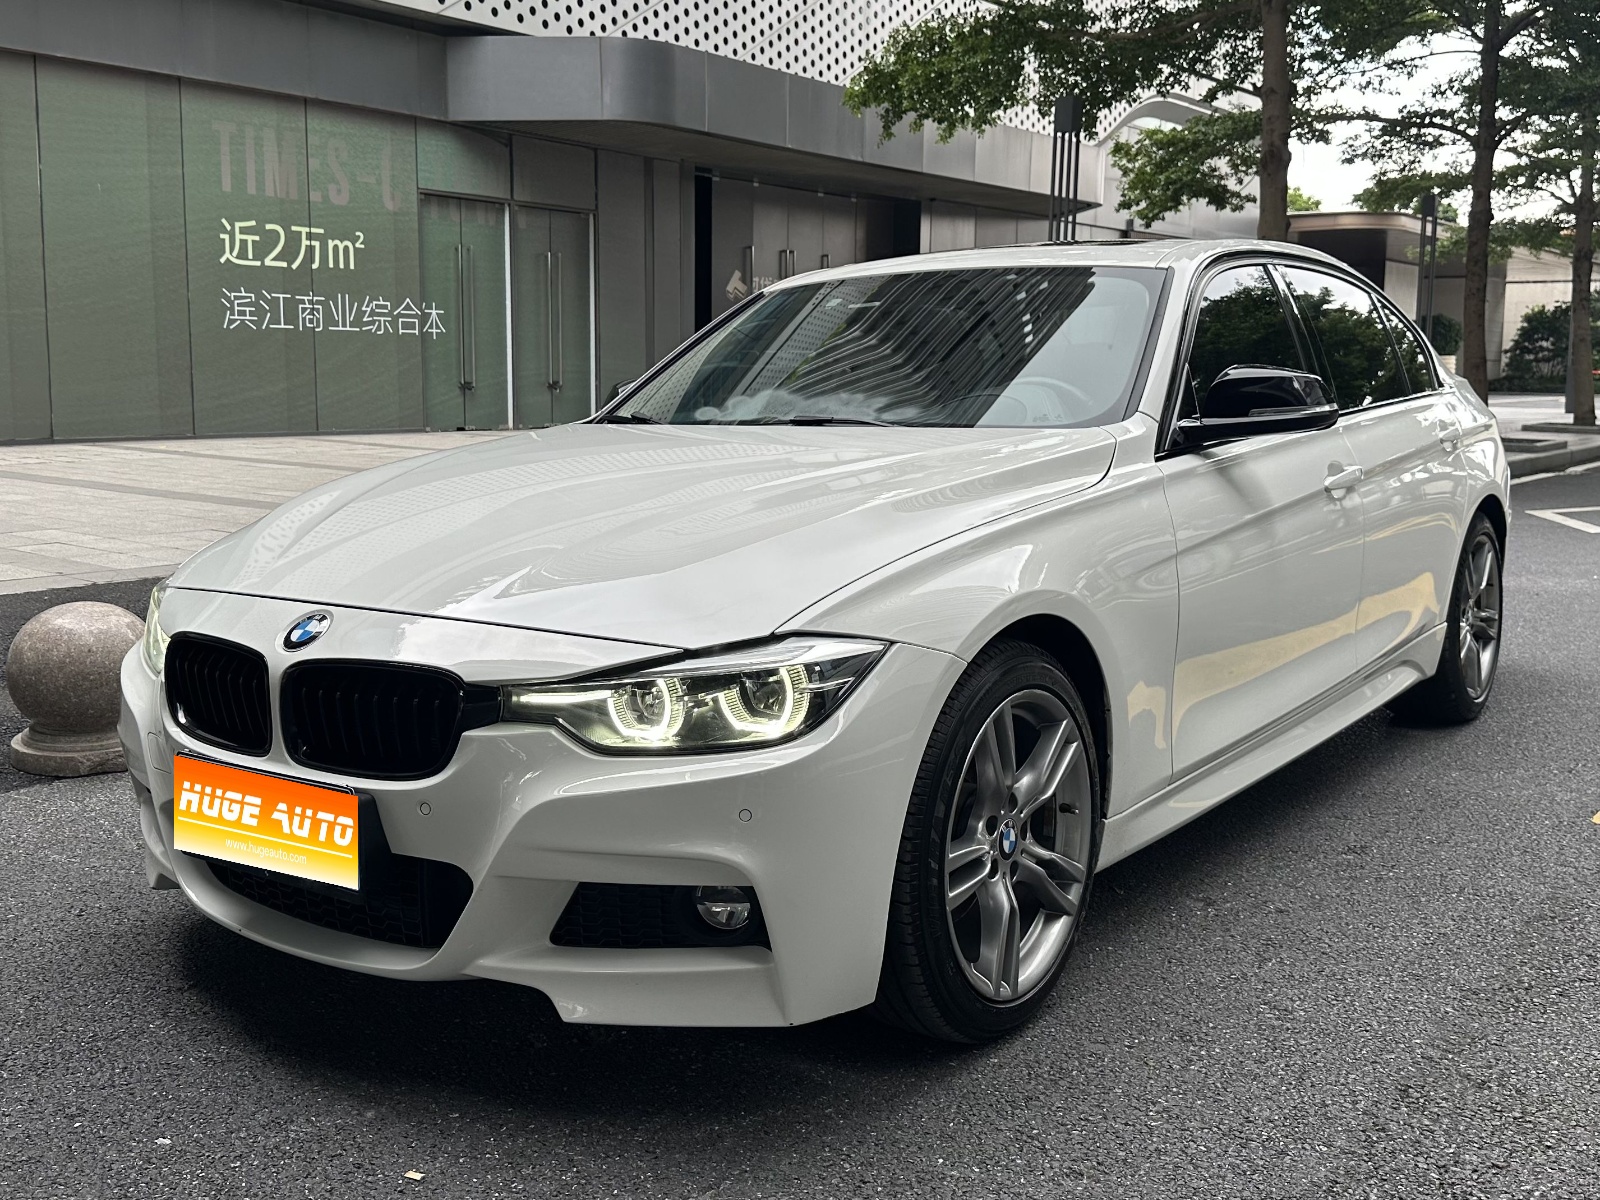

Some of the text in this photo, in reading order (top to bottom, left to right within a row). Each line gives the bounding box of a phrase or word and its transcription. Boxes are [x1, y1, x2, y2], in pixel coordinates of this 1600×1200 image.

[220, 286, 446, 340] 滨江商业综合体
